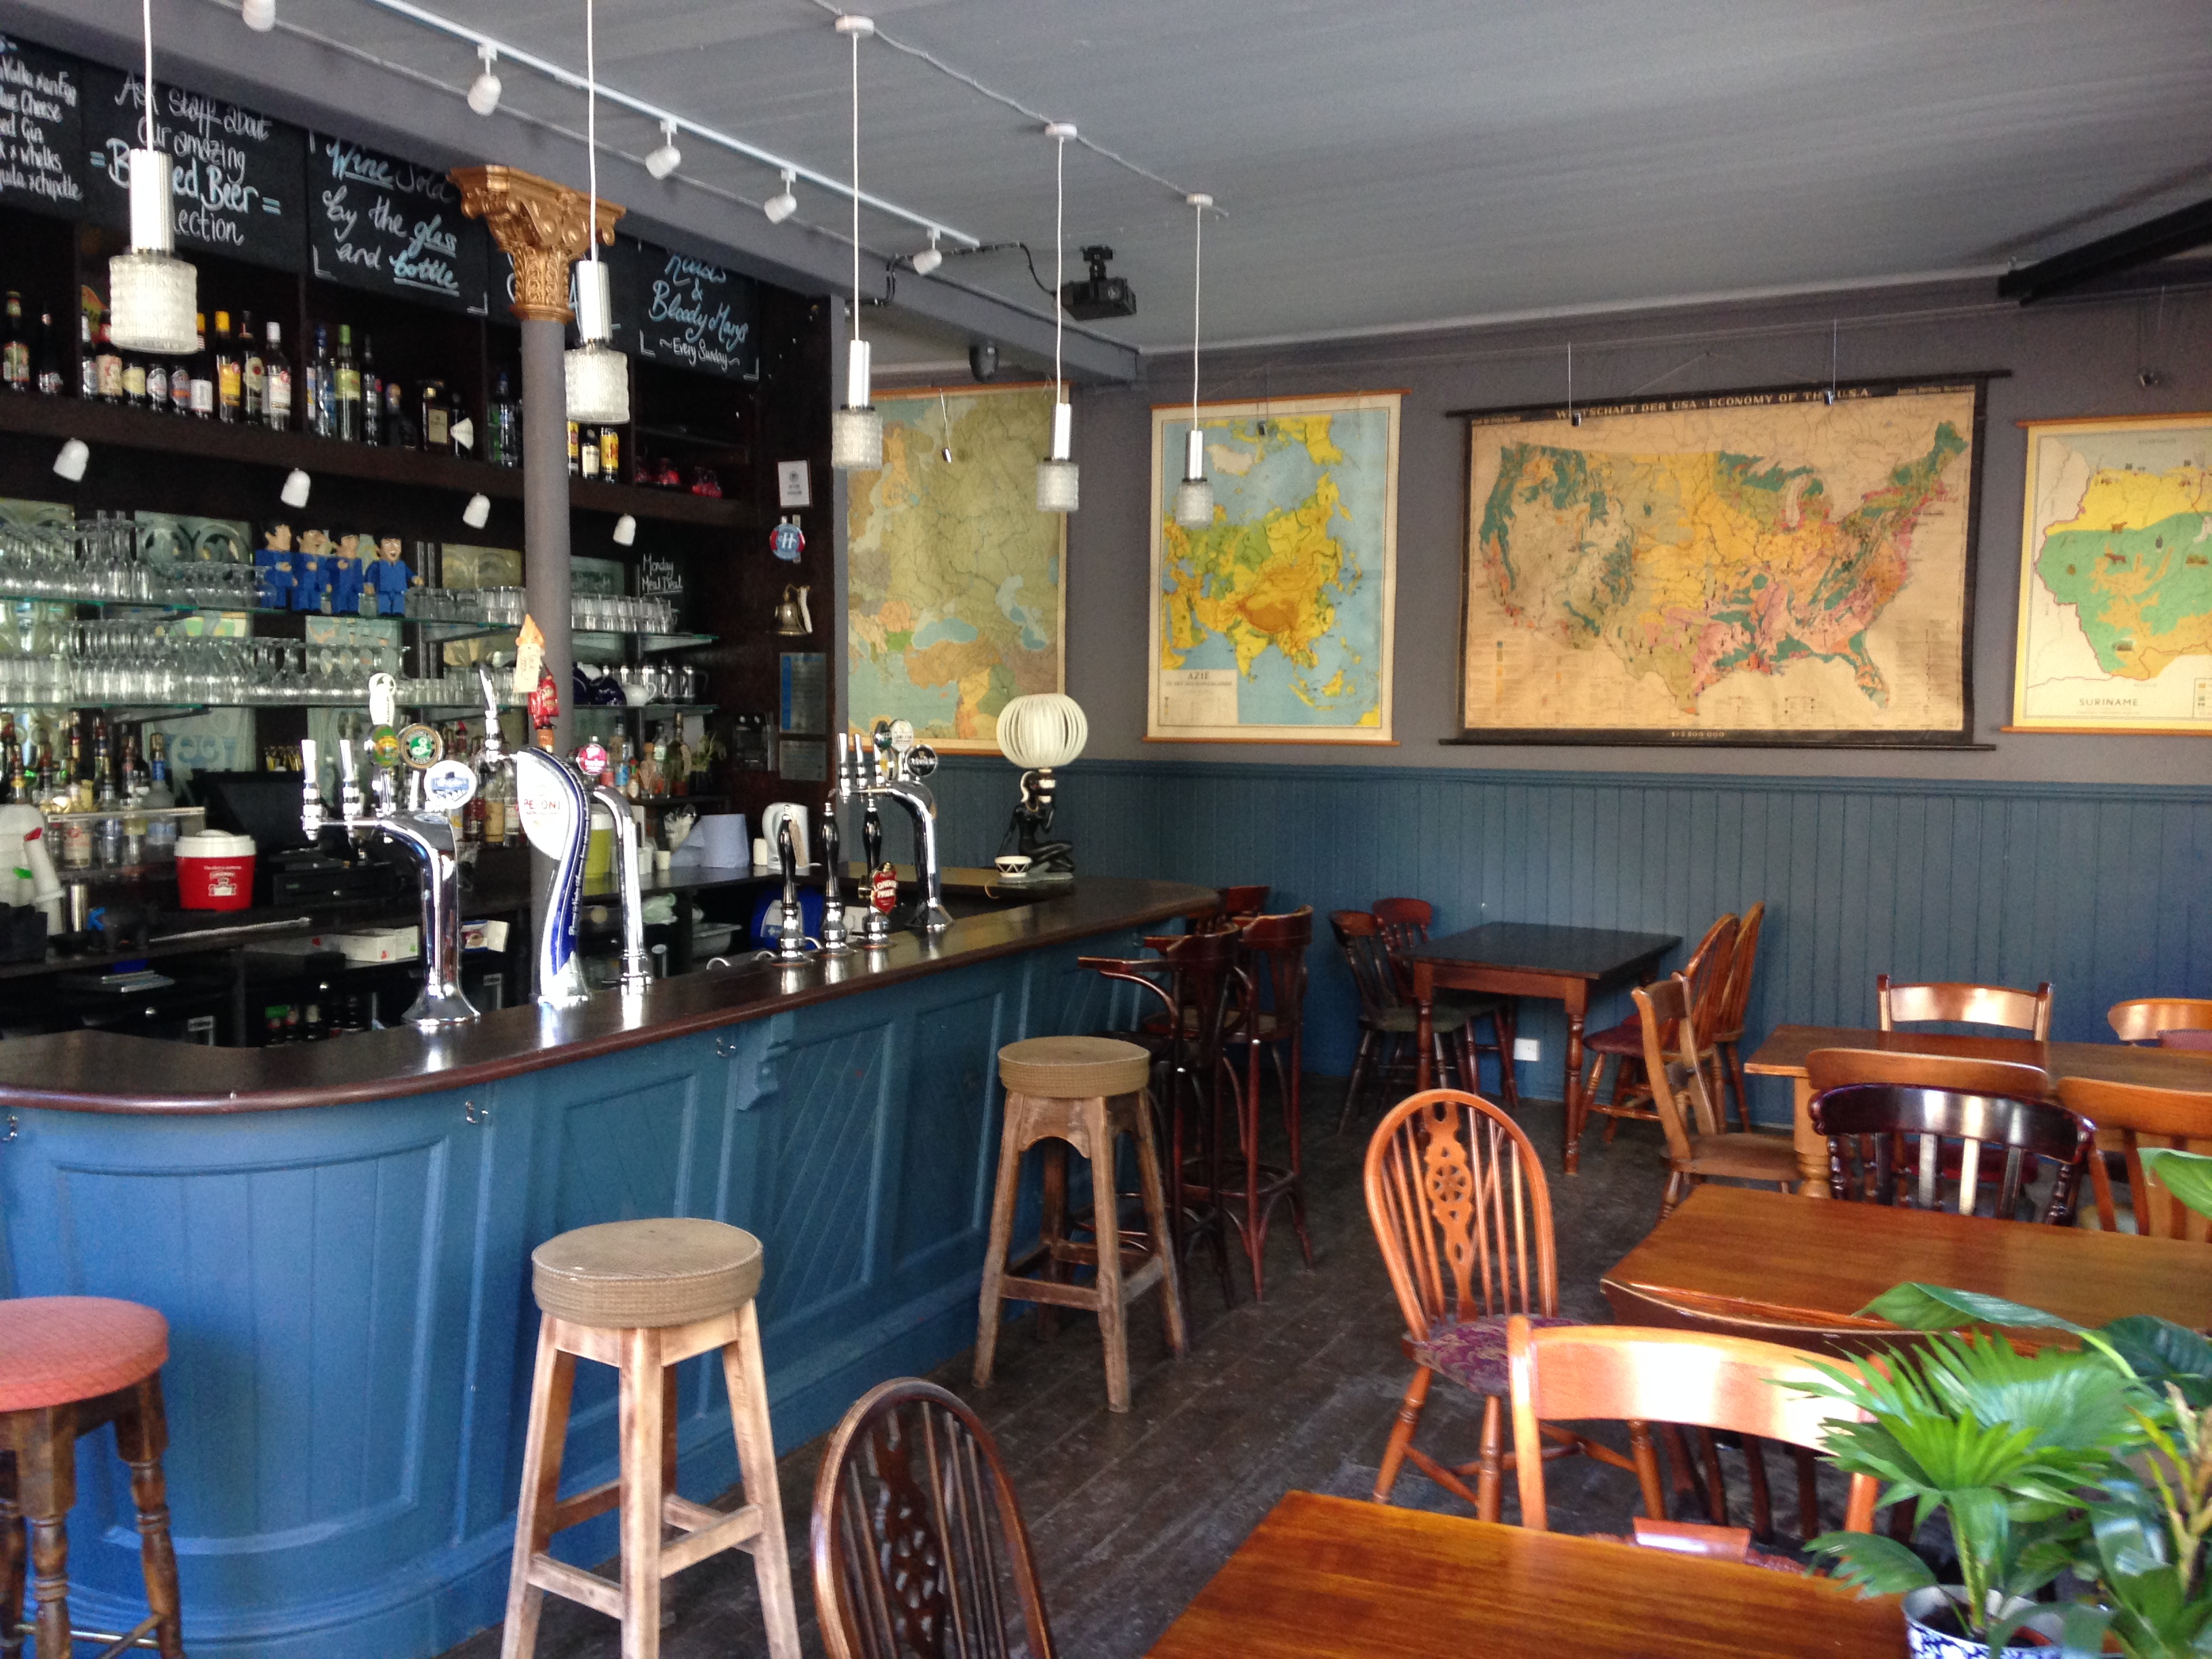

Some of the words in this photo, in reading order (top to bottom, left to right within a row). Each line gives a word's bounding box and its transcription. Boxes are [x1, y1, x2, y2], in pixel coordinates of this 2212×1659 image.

[21, 117, 44, 144] Gin
[174, 131, 245, 186] amazing
[201, 165, 259, 213] Beer
[173, 203, 245, 246] ection
[322, 185, 358, 243] by
[368, 195, 407, 237] the
[408, 214, 457, 259] glass
[335, 243, 381, 270] and
[389, 250, 459, 289] bottle
[649, 280, 708, 343] Bloody
[673, 337, 697, 367] Every
[698, 339, 728, 373] Sunday
[1556, 405, 1637, 419] WTSCHAFT
[1641, 402, 1666, 413] DER
[1673, 399, 1697, 411] USA
[1708, 394, 1774, 407] ECONOMY
[1779, 392, 1797, 403] OF
[643, 553, 673, 579] Monday
[2079, 697, 2139, 706] SURINAME
[524, 798, 560, 810] PEONI
